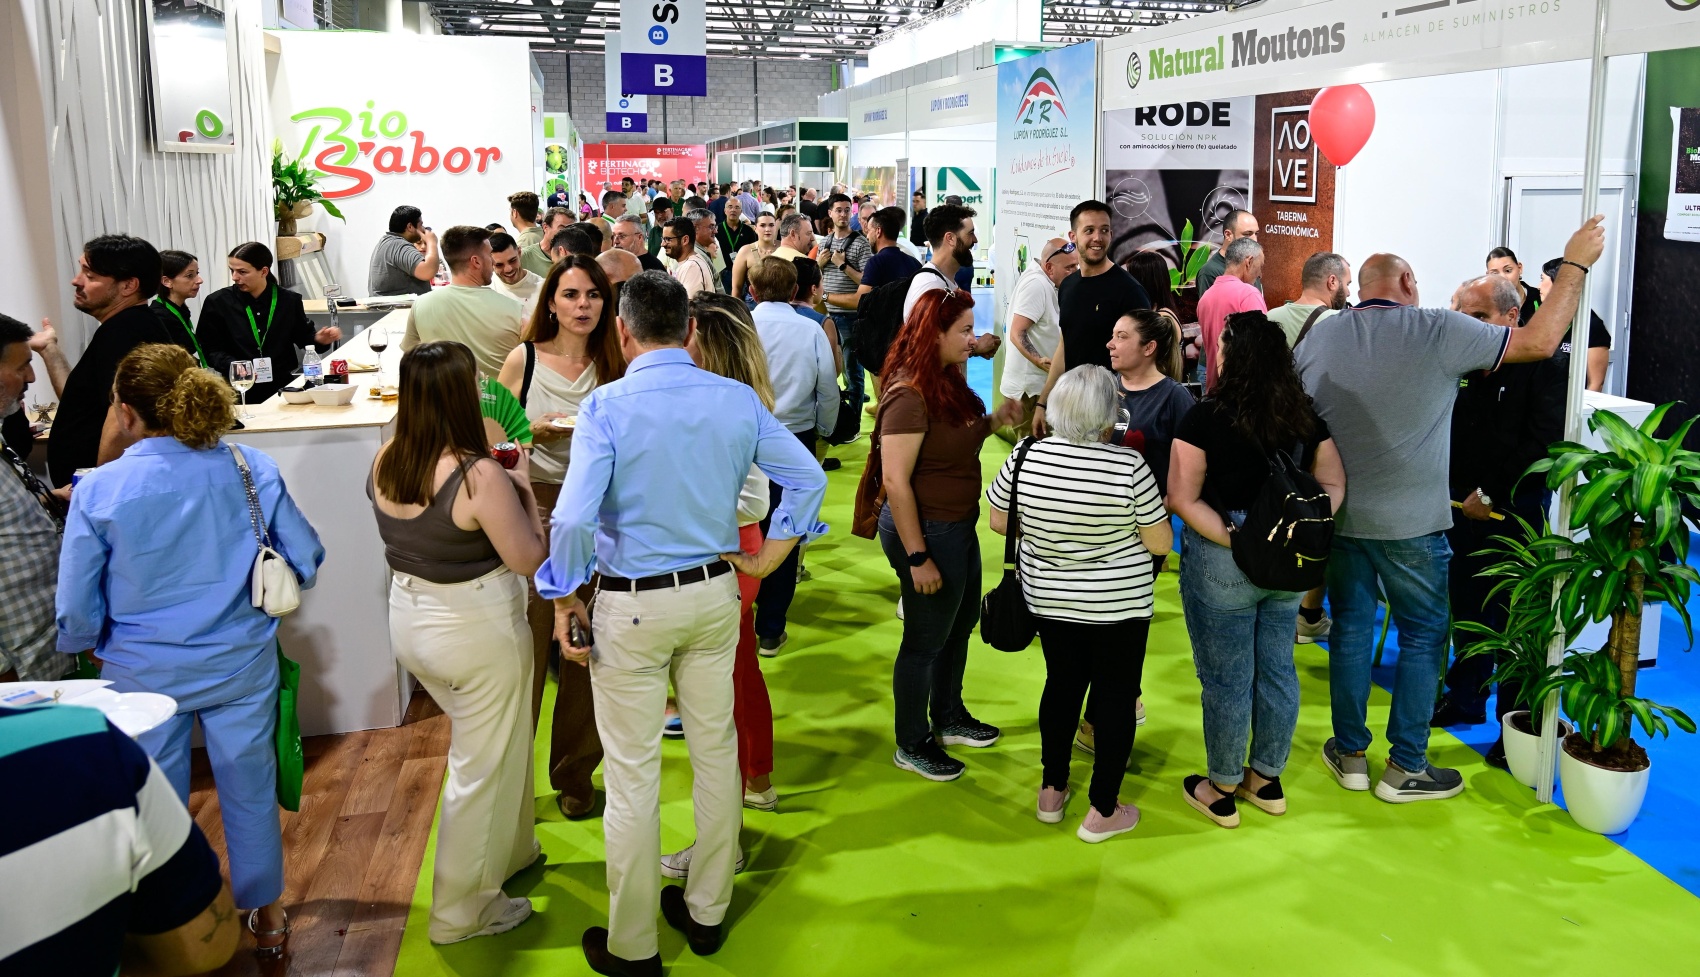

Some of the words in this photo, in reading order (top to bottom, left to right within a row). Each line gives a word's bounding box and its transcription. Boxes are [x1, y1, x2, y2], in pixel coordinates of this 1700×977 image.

[1362, 24, 1420, 43] ALMACÉN
[1428, 20, 1444, 33] DE
[1453, 0, 1561, 28] SUMINISTROS
[1148, 35, 1224, 81] Natural
[1231, 21, 1346, 68] Moutons
[654, 63, 674, 87] B
[622, 116, 632, 128] B
[1135, 101, 1231, 126] RODE
[291, 99, 408, 177] Bio
[1014, 128, 1028, 140] LUPIÓN
[1033, 126, 1058, 138] RODRÍGUEZ
[1141, 133, 1193, 141] SOLUCIÓN
[315, 130, 501, 199] Sabor
[937, 194, 982, 204] Kpert
[1276, 210, 1308, 222] TABERNA
[1265, 224, 1319, 238] GASTRONÓMICA
